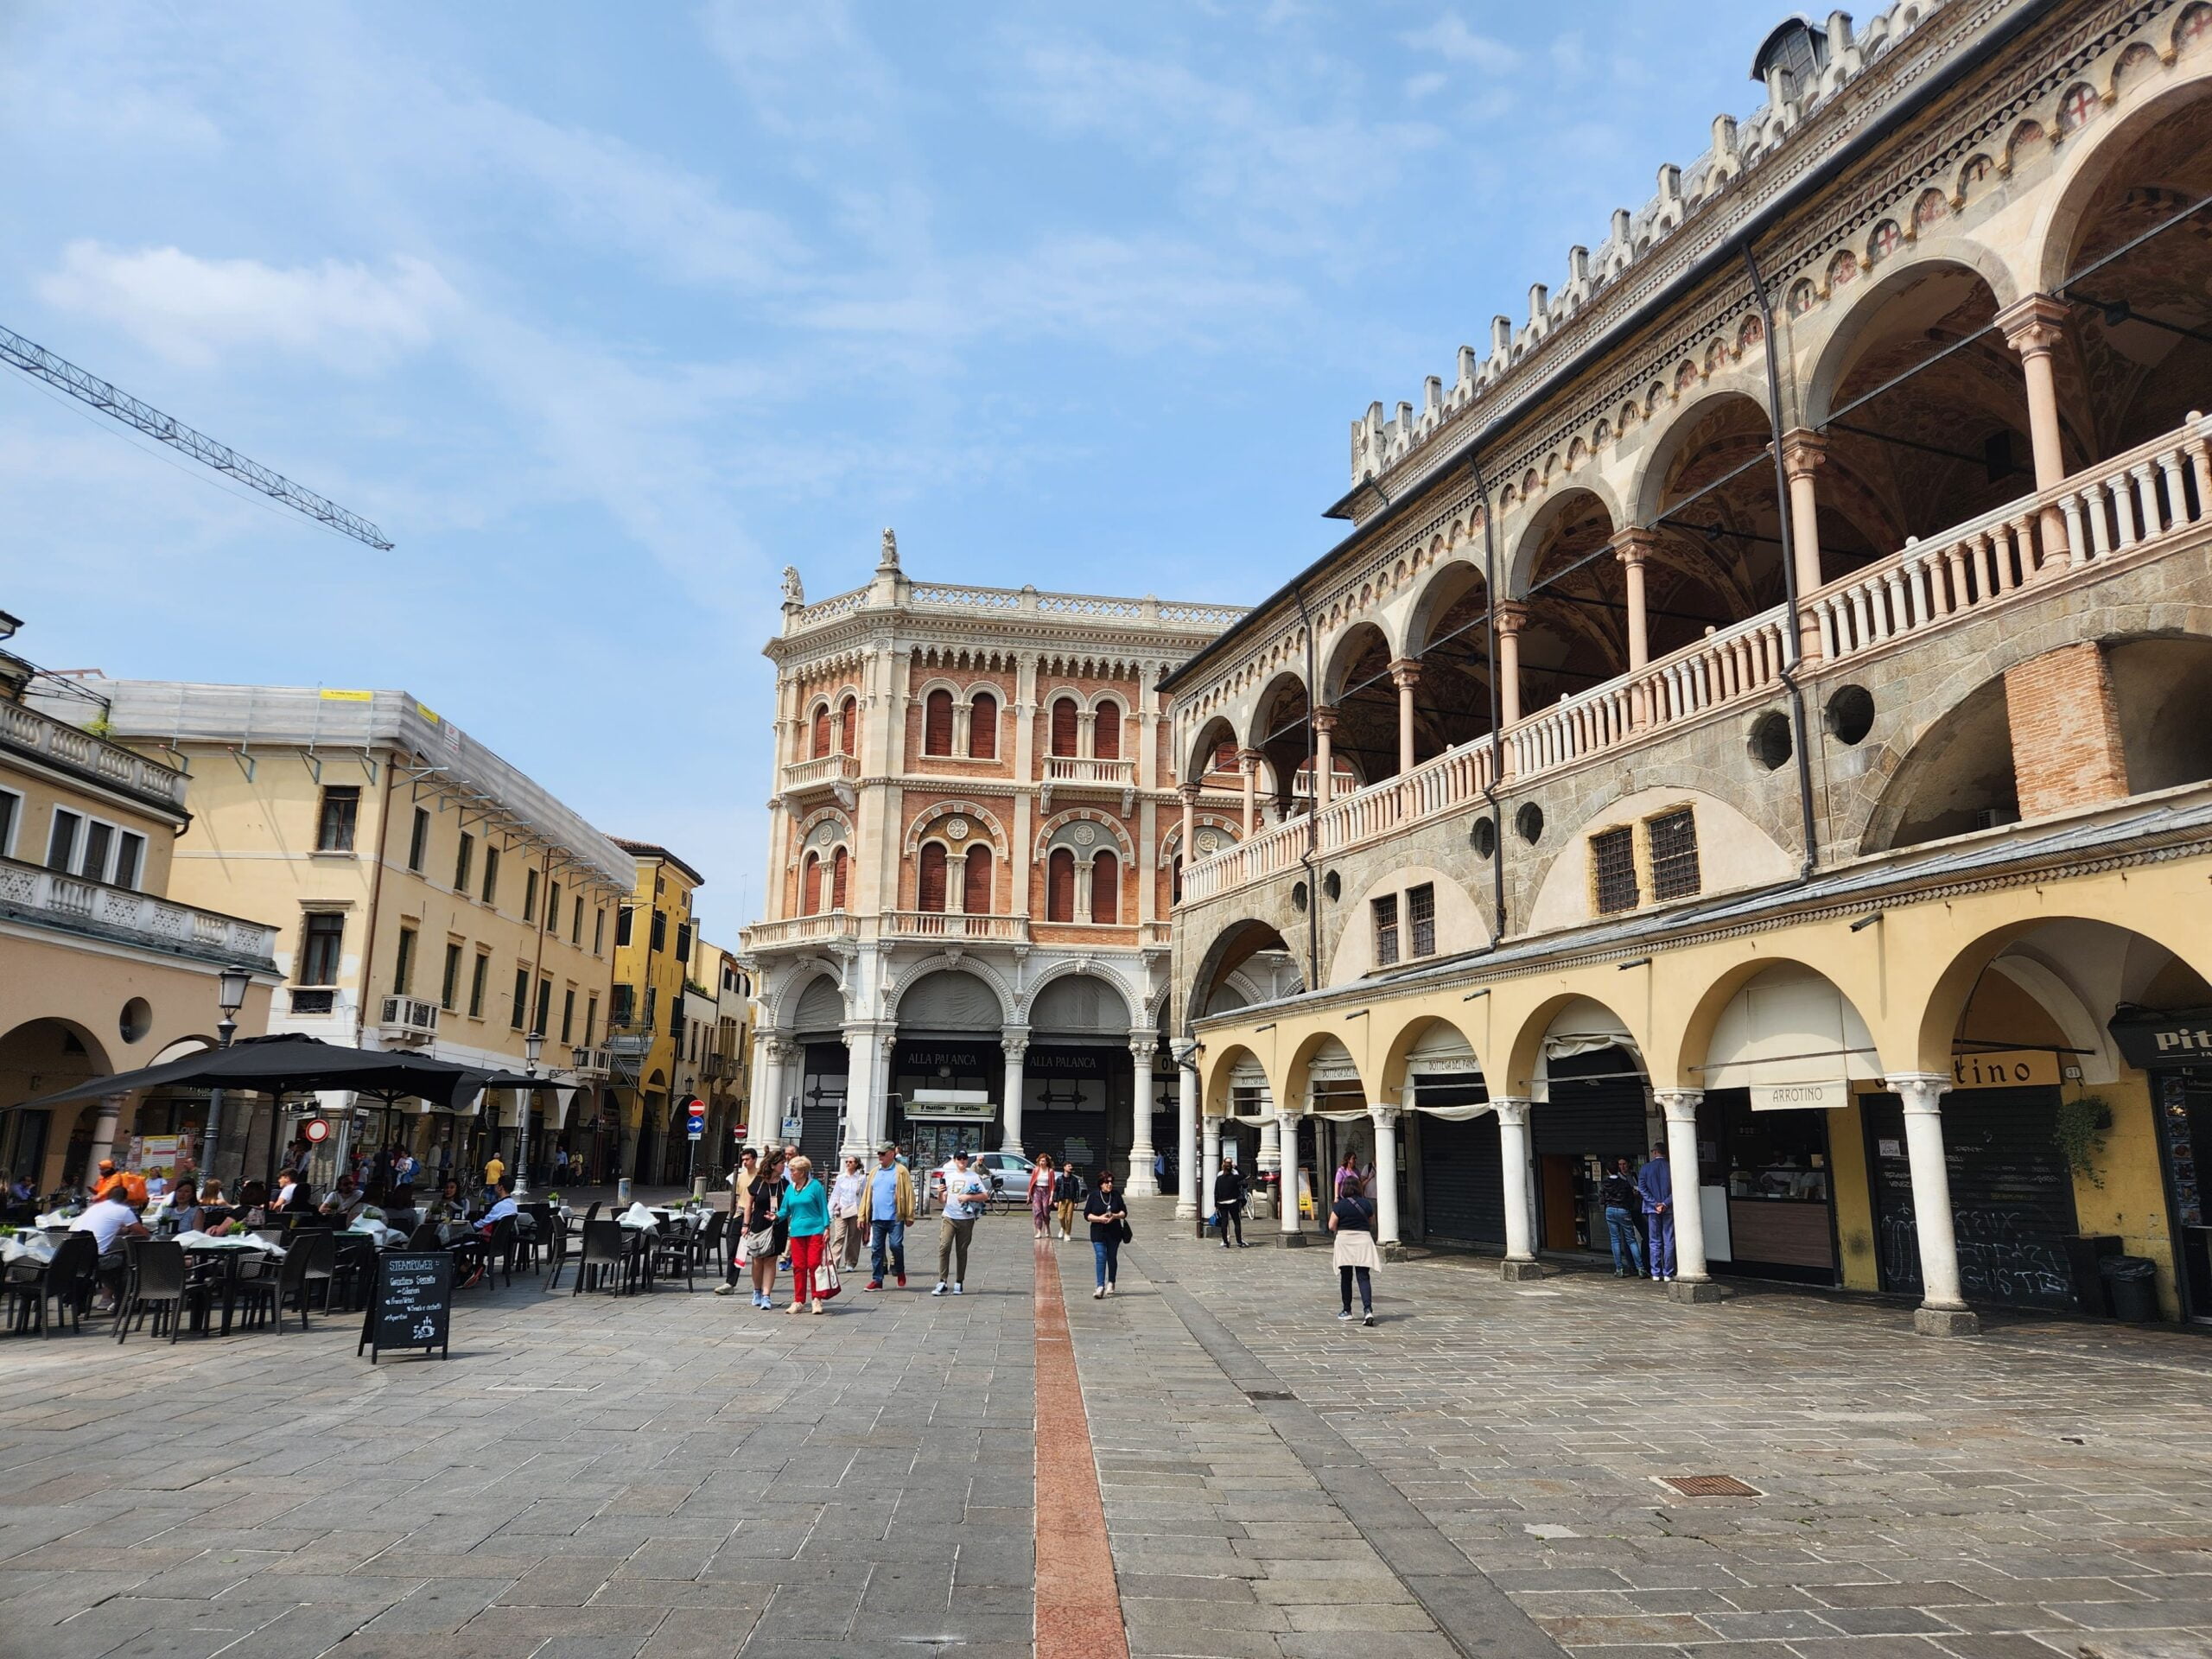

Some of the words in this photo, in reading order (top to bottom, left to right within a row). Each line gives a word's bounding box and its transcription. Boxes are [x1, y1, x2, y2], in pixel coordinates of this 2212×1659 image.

[908, 1053, 931, 1065] ALLA
[1030, 1056, 1052, 1067] ALLA
[1056, 1057, 1096, 1068] PALANCA
[1429, 1061, 1452, 1071] BOTTEGA
[1452, 1060, 1462, 1070] DEL
[1463, 1059, 1476, 1070] PANE
[2068, 1068, 2078, 1077] 31
[1772, 1087, 1823, 1103] ARROTINO
[390, 1261, 433, 1271] STEAMPOWER
